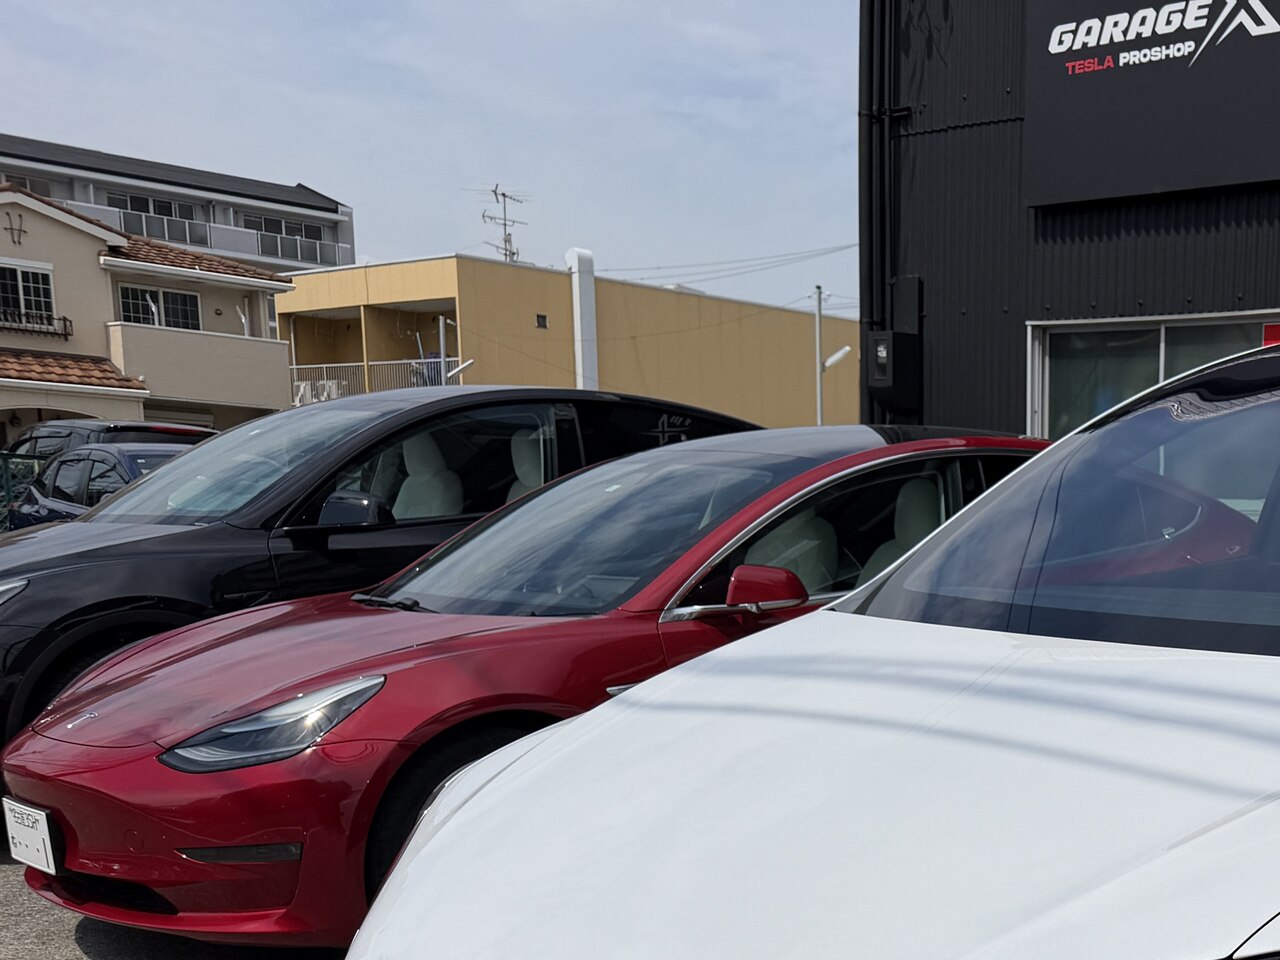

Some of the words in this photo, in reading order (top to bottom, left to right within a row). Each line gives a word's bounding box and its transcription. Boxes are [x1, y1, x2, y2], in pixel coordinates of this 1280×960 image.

[1048, 0, 1213, 54] GARAGE
[1065, 55, 1115, 75] TESLA
[1118, 40, 1196, 67] PROSHOP
